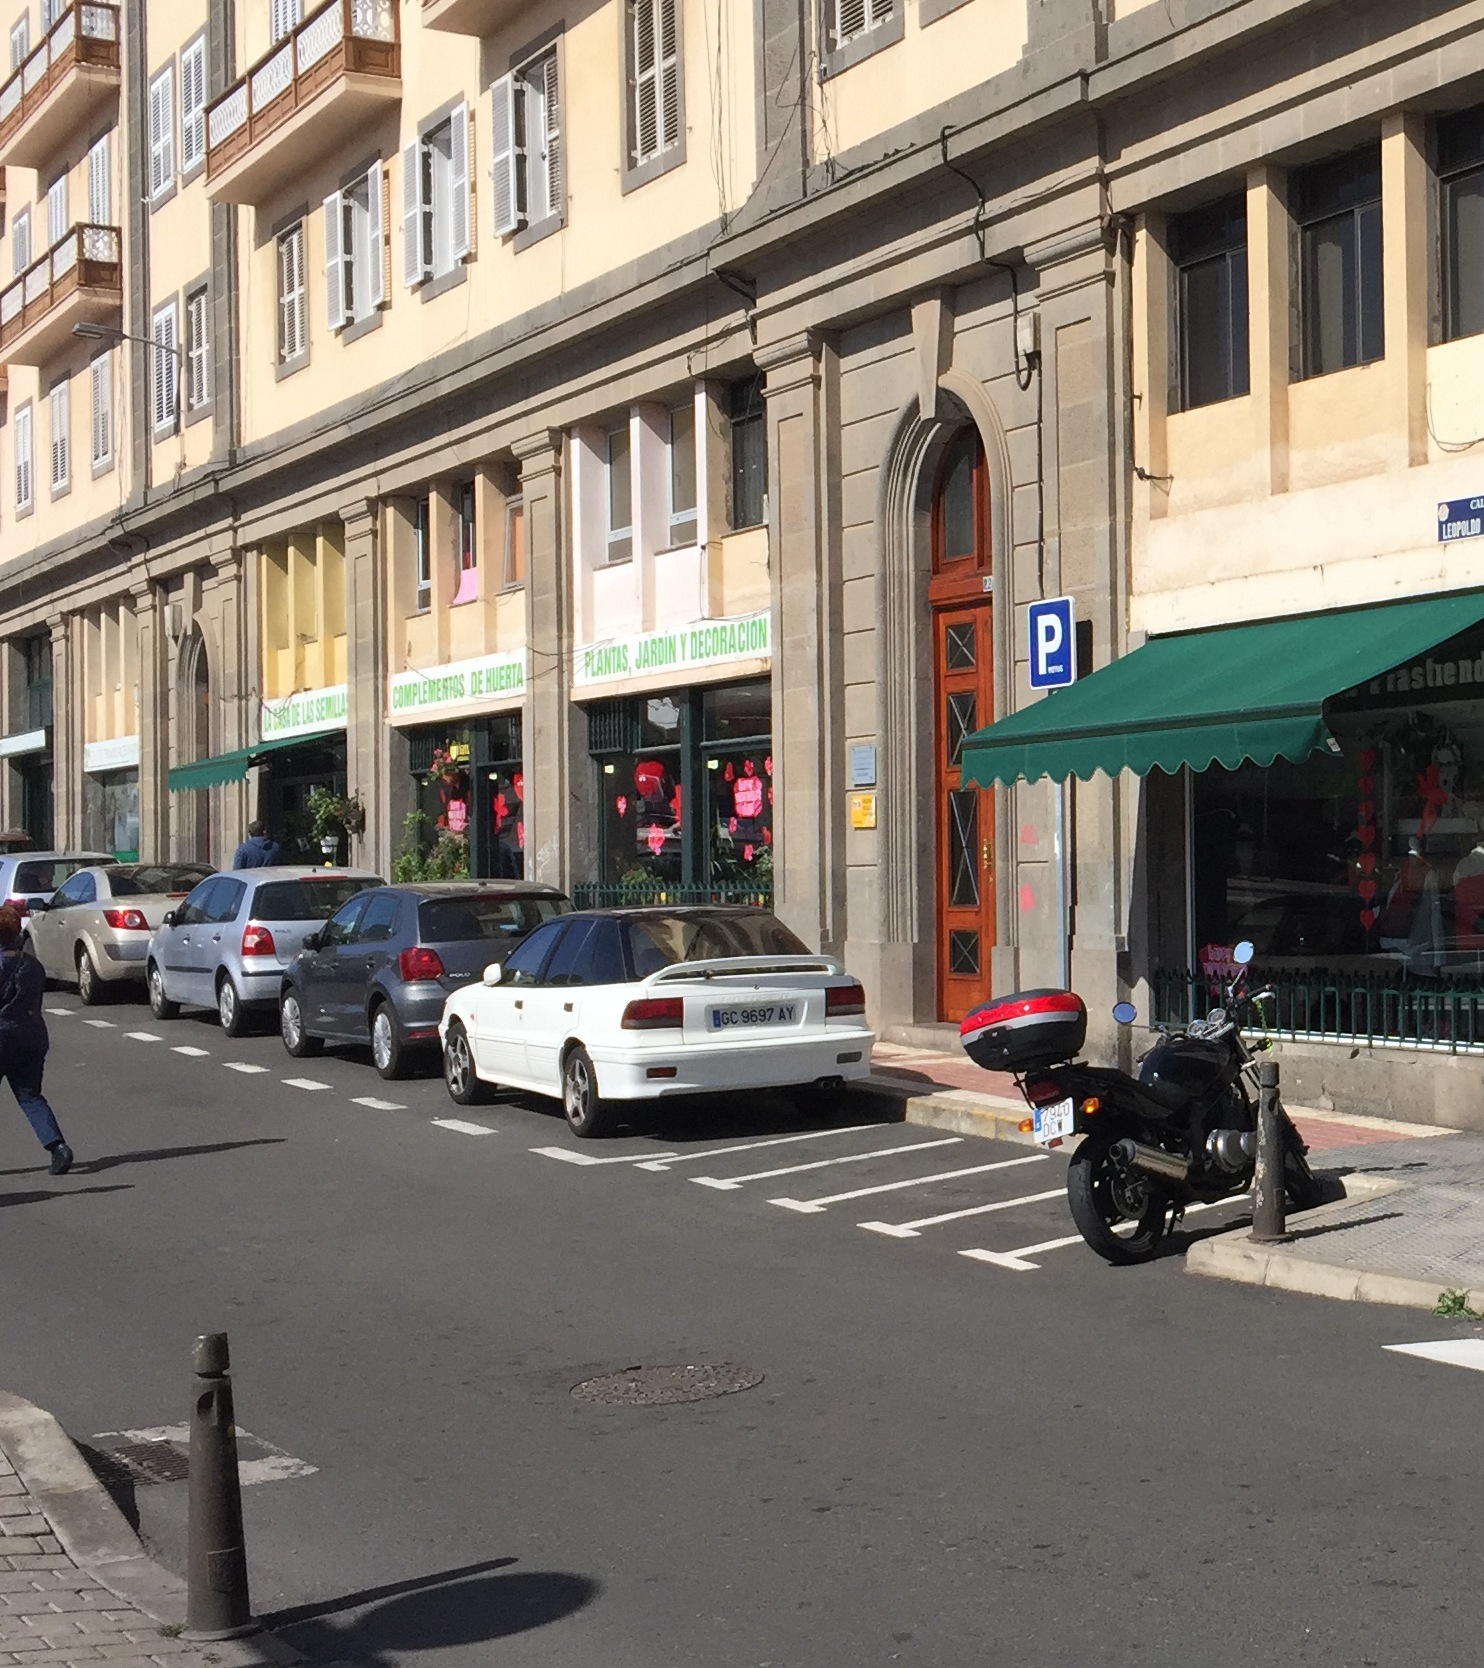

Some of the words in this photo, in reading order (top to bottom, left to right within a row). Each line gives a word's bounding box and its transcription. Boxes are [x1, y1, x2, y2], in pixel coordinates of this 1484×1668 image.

[1442, 518, 1481, 540] LEOPOLDO
[584, 643, 632, 679] PLANTAS,
[635, 630, 677, 671] JARDÍN
[680, 632, 688, 662] Y
[1037, 613, 1063, 675] P
[392, 673, 465, 709] COMPLEMENTOS
[470, 670, 483, 695] DE
[485, 662, 524, 693] HUERTA
[315, 692, 348, 722] SEMILLA
[721, 1010, 739, 1026] GC
[741, 1007, 774, 1024] 9697
[778, 1006, 794, 1021] AY
